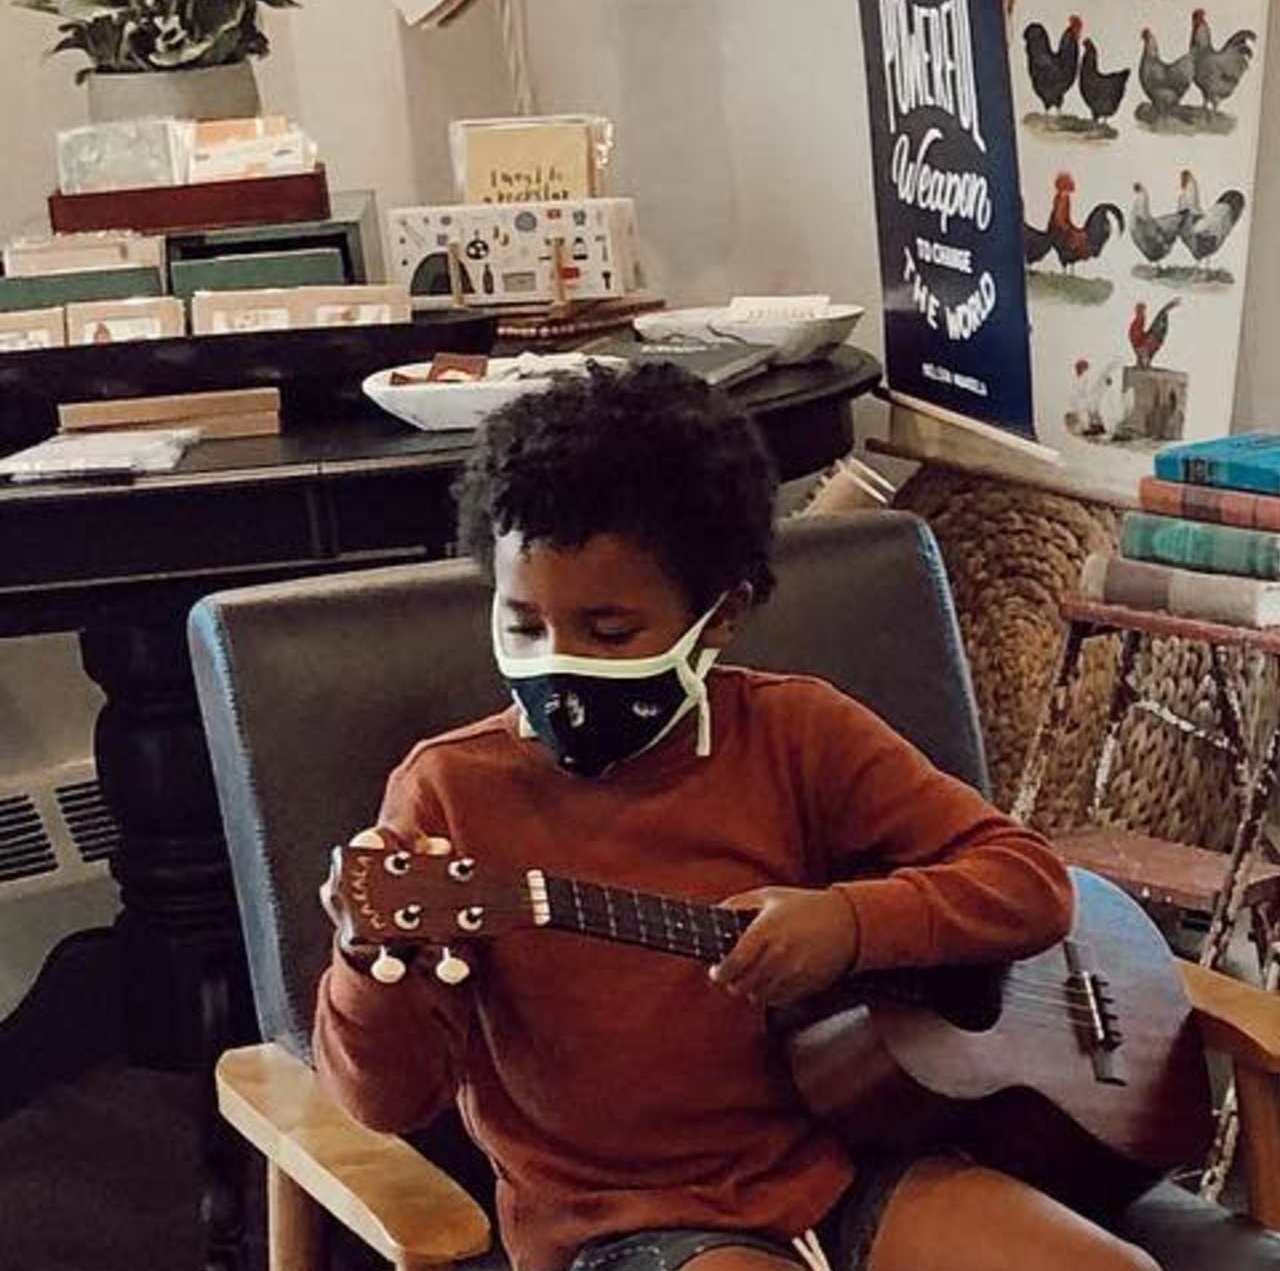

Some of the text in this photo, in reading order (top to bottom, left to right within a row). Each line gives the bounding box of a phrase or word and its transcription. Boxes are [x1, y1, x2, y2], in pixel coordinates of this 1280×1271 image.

[892, 127, 992, 233] Weapon
[903, 244, 996, 341] THE WORLD
